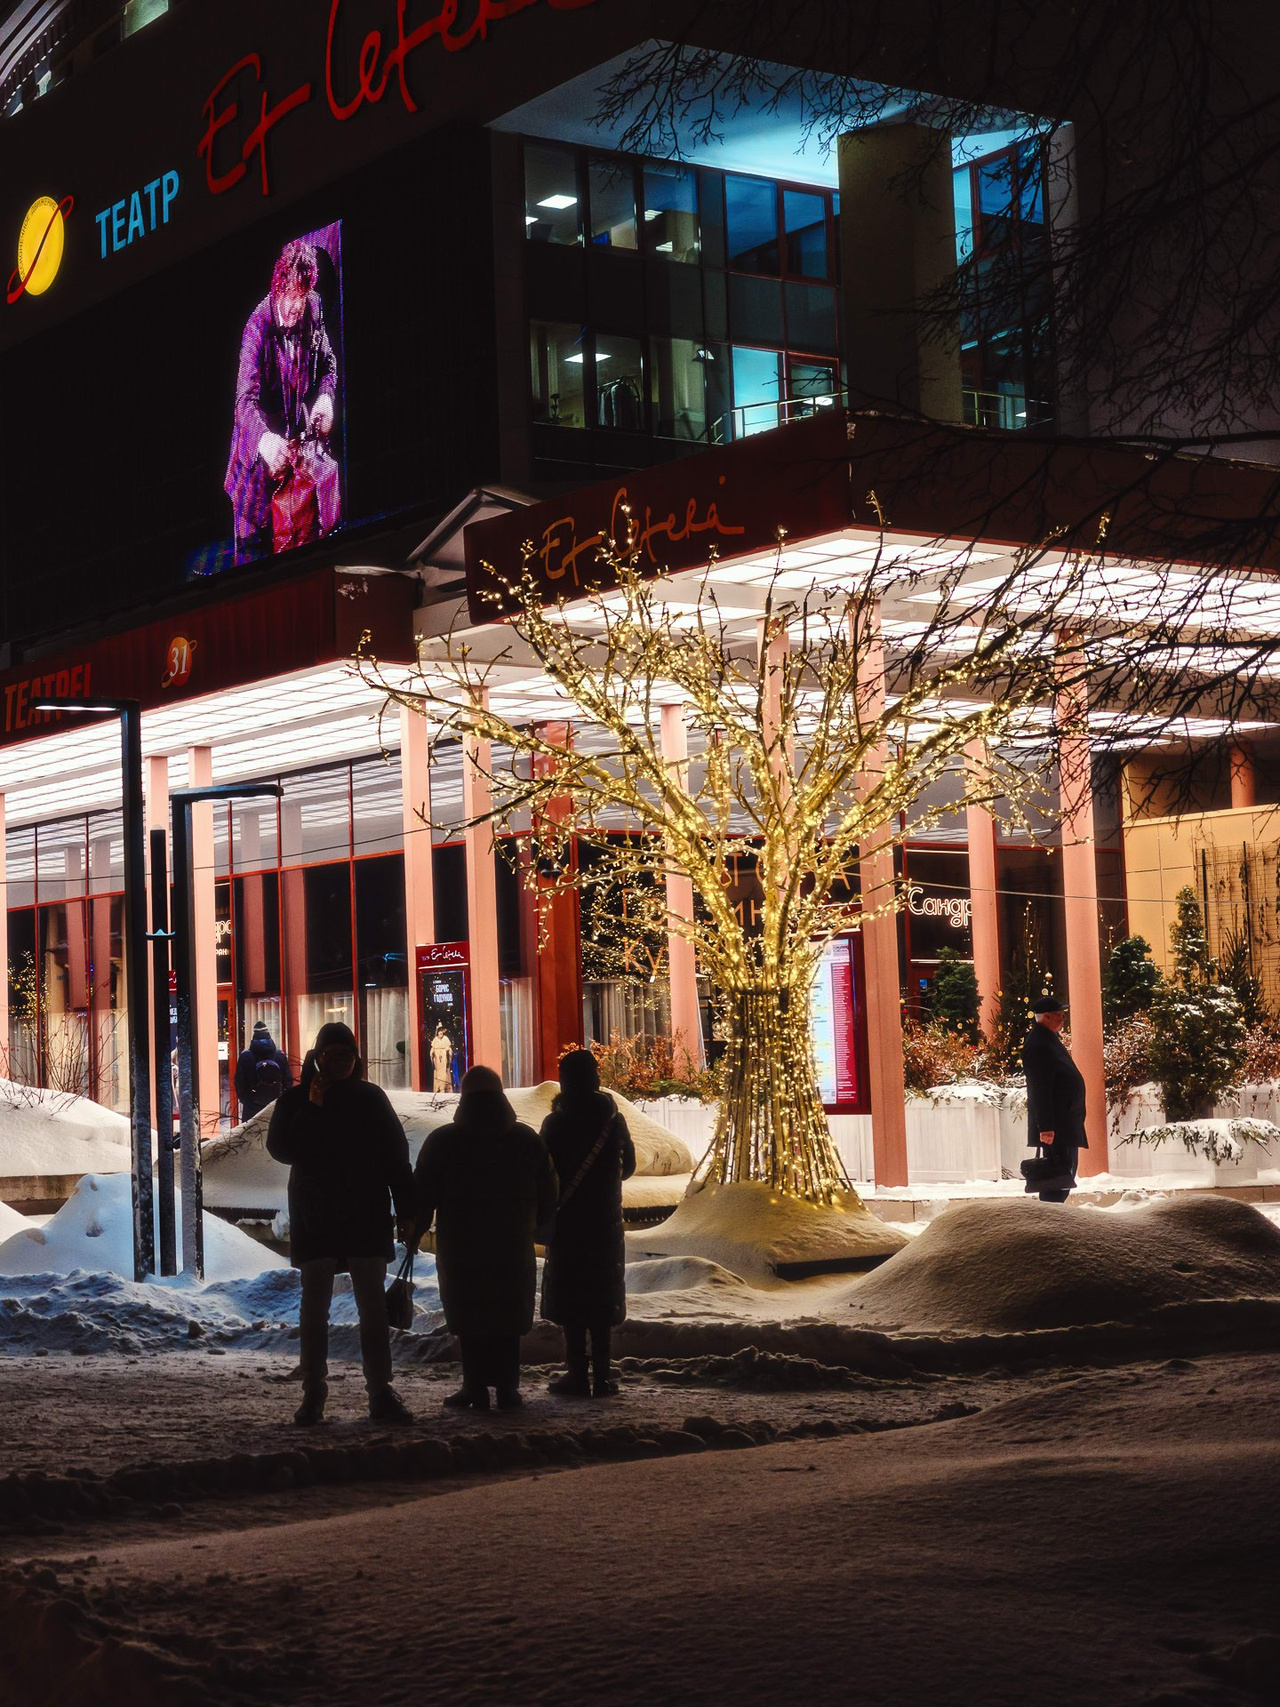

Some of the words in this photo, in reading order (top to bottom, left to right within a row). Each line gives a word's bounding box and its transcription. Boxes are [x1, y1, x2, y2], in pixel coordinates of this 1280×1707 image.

[197, 52, 312, 196] Et
[325, 0, 600, 120] Cete
[96, 170, 180, 259] ТЕАТР
[540, 516, 602, 586] Et
[169, 645, 189, 677] 31
[908, 886, 973, 928] Сандр
